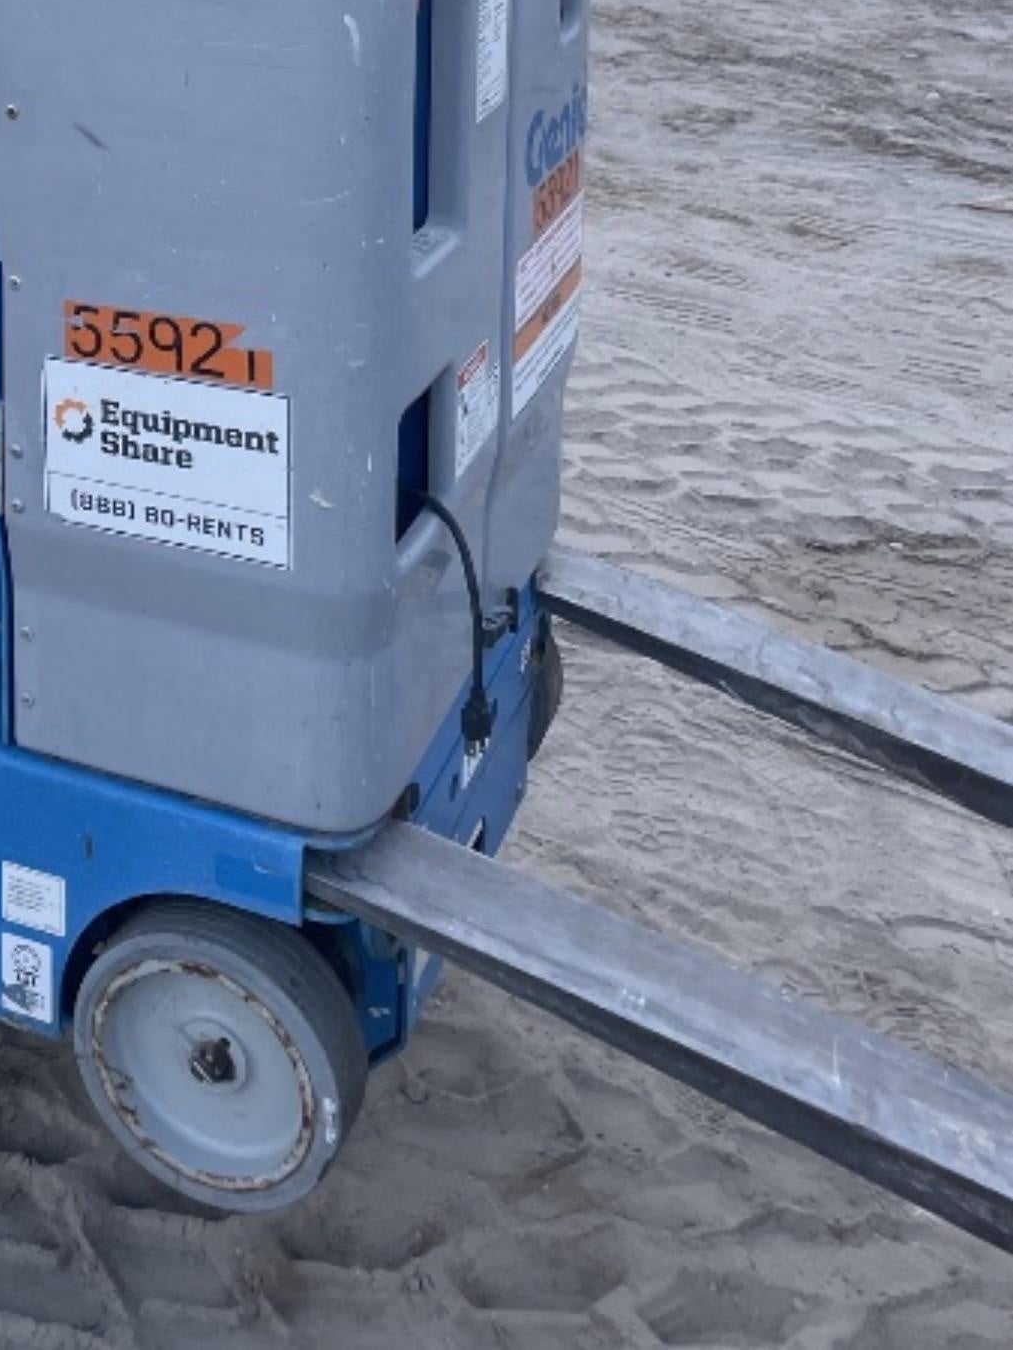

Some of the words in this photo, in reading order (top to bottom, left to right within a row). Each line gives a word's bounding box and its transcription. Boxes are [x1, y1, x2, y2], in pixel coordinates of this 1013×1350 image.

[70, 304, 256, 382] 55921
[100, 398, 280, 456] Equipment
[100, 430, 194, 469] Share
[70, 488, 136, 520] (888)
